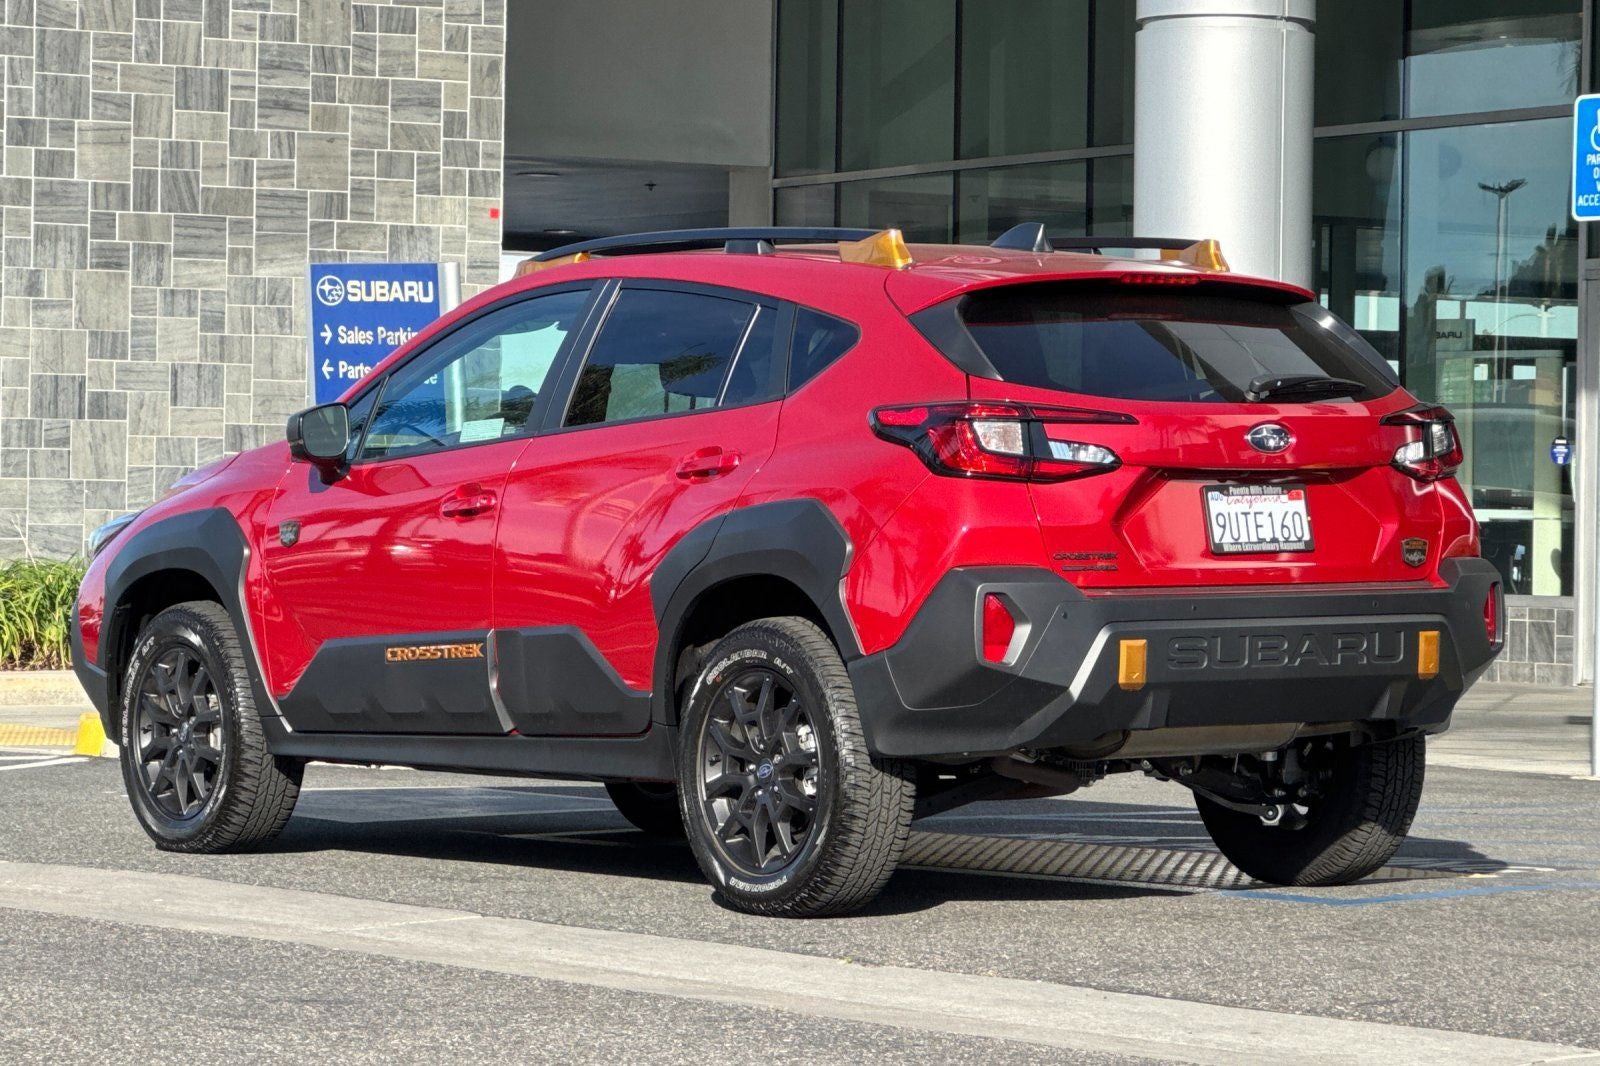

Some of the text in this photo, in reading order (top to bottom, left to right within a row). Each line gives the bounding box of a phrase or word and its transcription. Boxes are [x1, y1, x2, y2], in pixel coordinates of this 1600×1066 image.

[347, 279, 434, 303] SUBARU
[337, 325, 419, 346] Sales Parki
[1227, 495, 1289, 509] California
[1215, 510, 1305, 543] 9UTE160
[1053, 551, 1118, 560] CROSSTREK
[1223, 542, 1242, 552] Where
[1242, 541, 1279, 551] Extraordinary
[386, 642, 485, 662] CROSSTREK
[1167, 631, 1405, 670] SUBARU
[706, 648, 795, 686] GEOLANDAR A/T
[729, 875, 788, 893] YOKOHAMA
